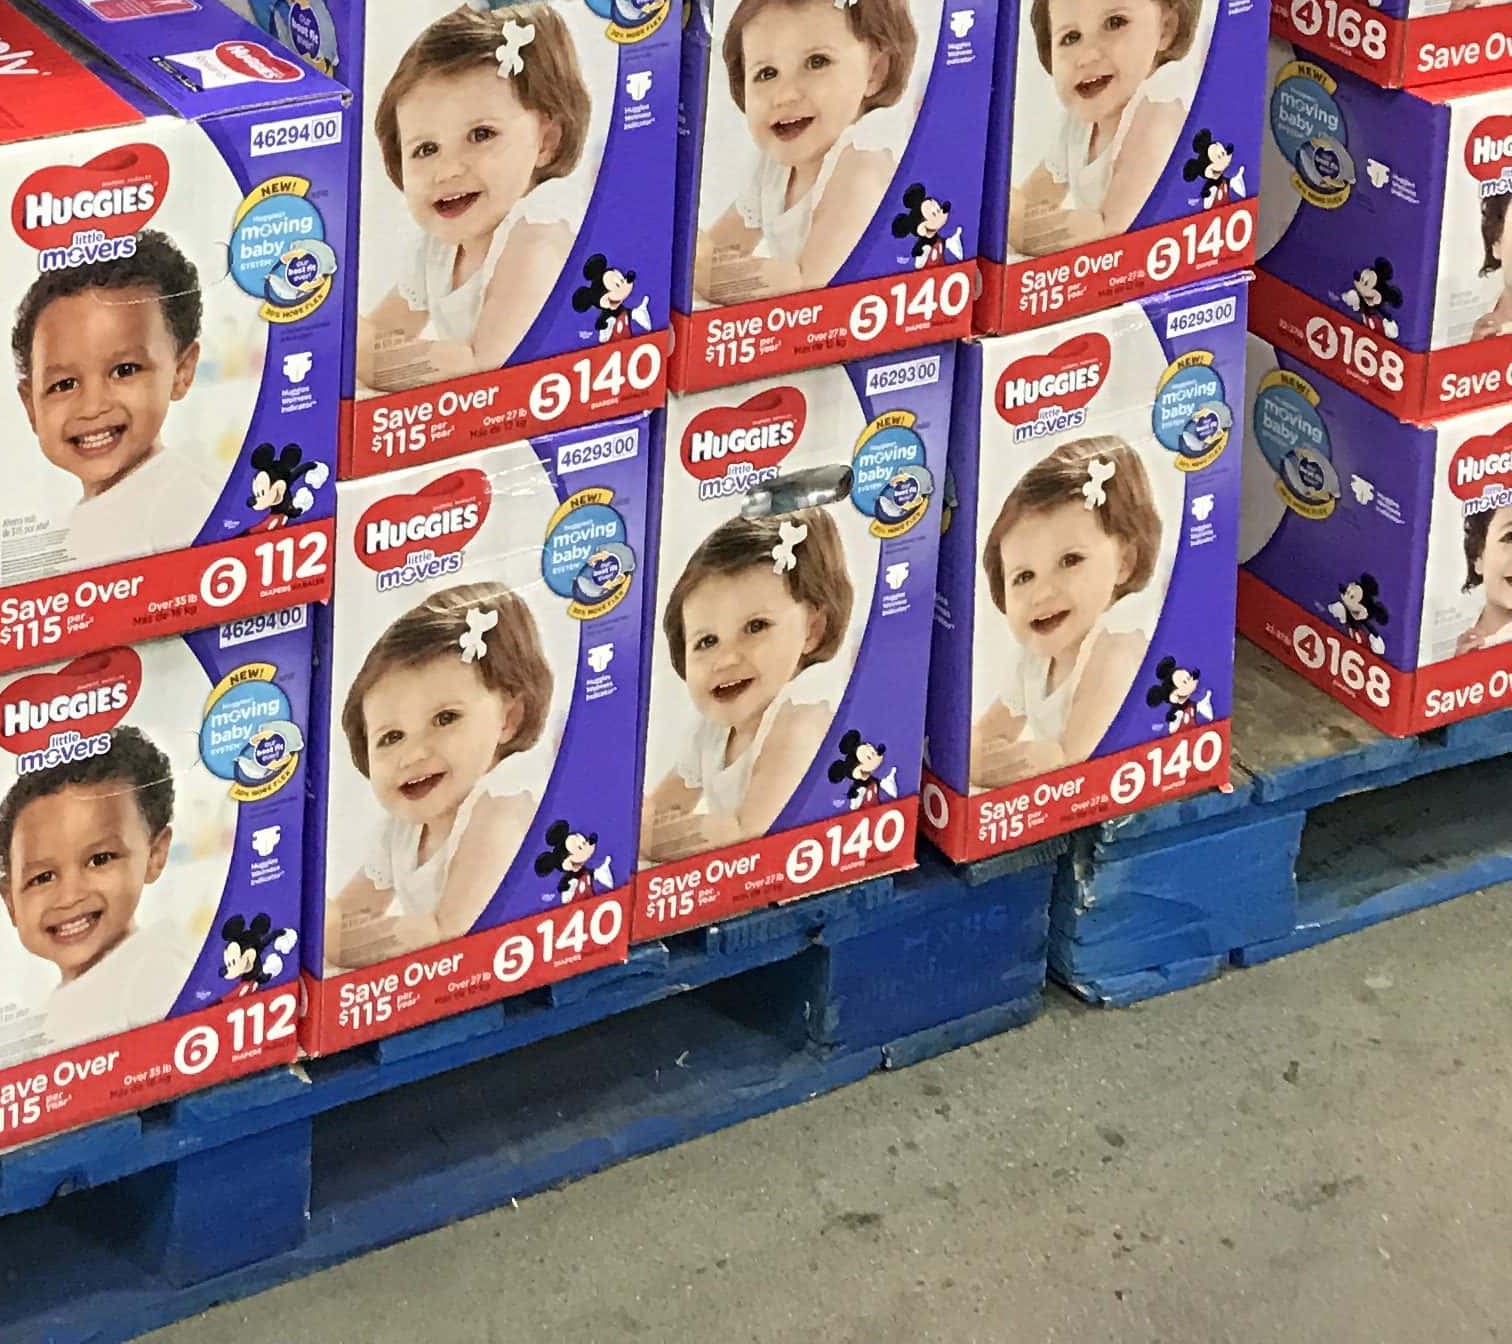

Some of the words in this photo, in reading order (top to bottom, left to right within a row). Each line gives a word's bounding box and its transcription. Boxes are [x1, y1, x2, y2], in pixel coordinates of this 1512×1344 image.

[24, 180, 157, 231] HUGGIES
[1178, 208, 1255, 264] 140
[1004, 365, 1101, 412] HUGGIES
[254, 531, 329, 587] 112
[1327, 644, 1392, 710] 168
[534, 898, 624, 962] 140
